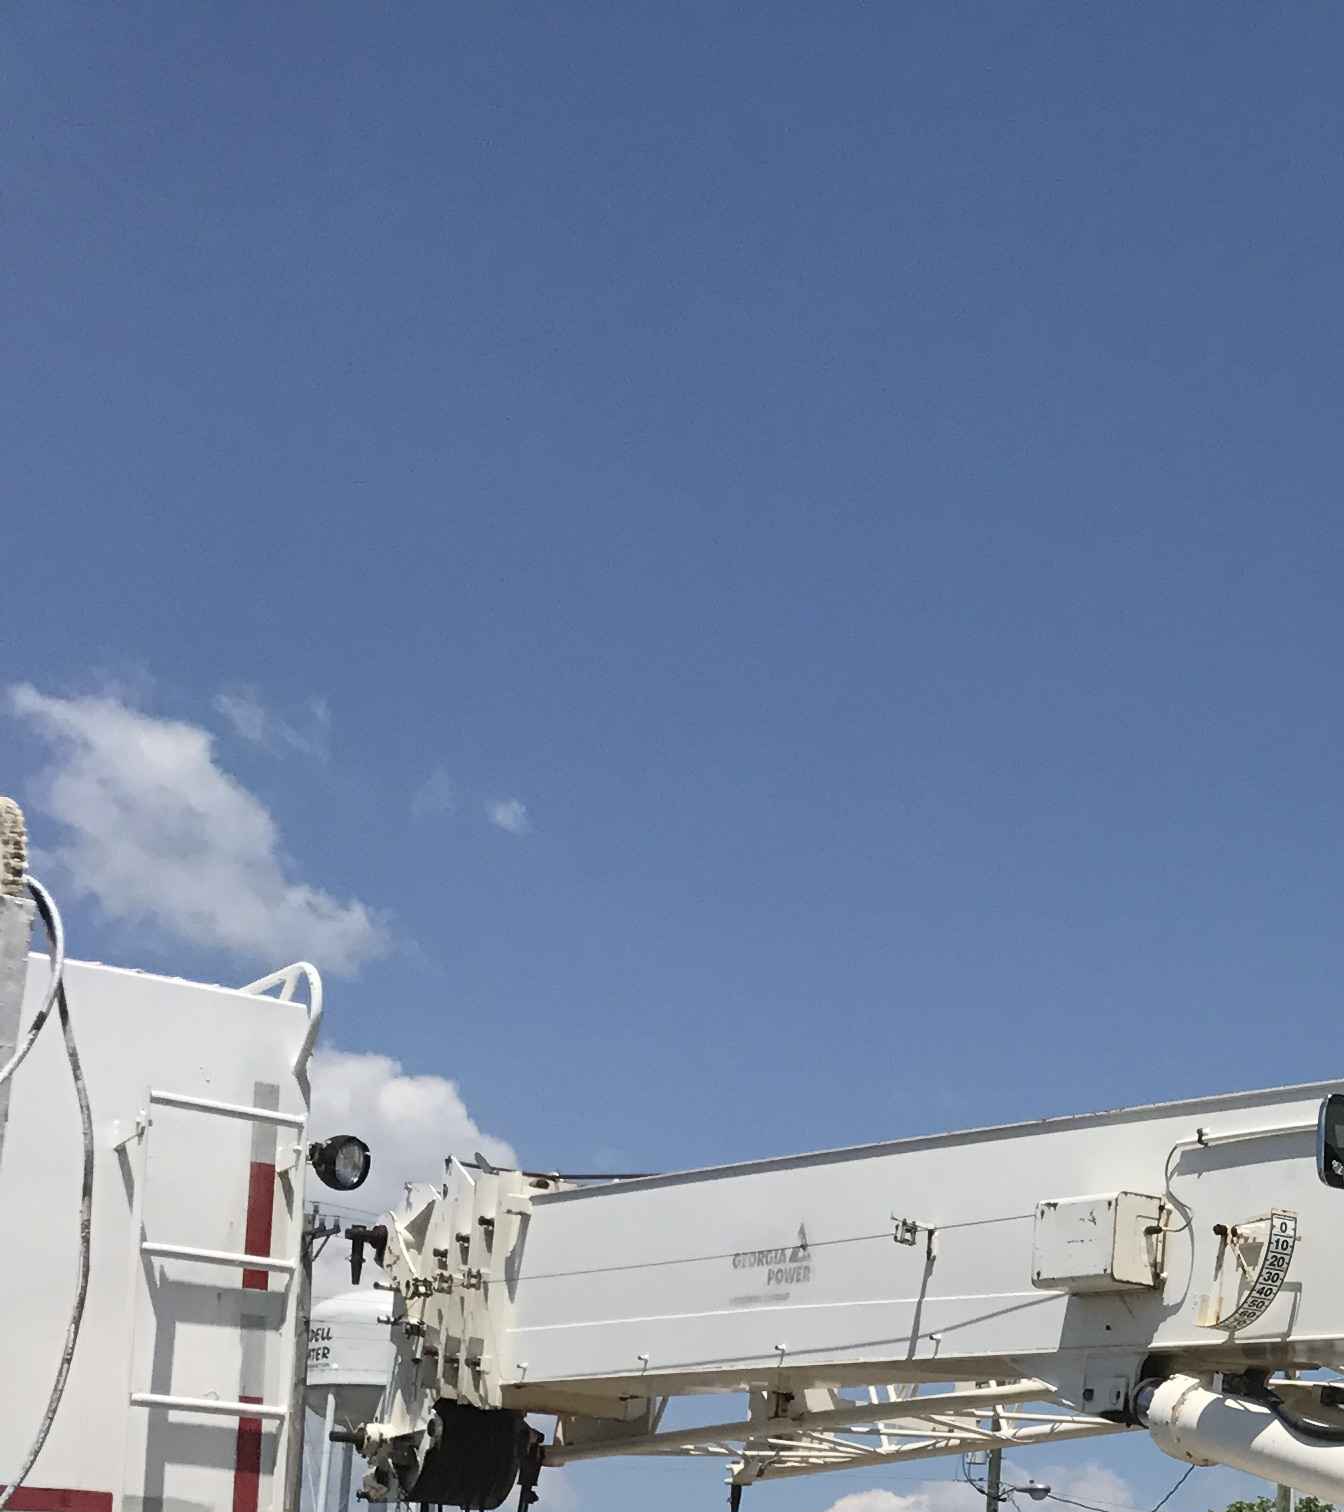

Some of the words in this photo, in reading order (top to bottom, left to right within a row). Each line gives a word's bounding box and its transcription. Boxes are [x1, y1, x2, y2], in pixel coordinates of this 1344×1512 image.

[1279, 1221, 1288, 1234] 0
[1273, 1238, 1289, 1251] 10
[1268, 1254, 1286, 1268] 20
[767, 1264, 810, 1285] POWER
[1263, 1271, 1280, 1283] 30
[1256, 1286, 1273, 1297] 40
[1248, 1299, 1266, 1309] 50
